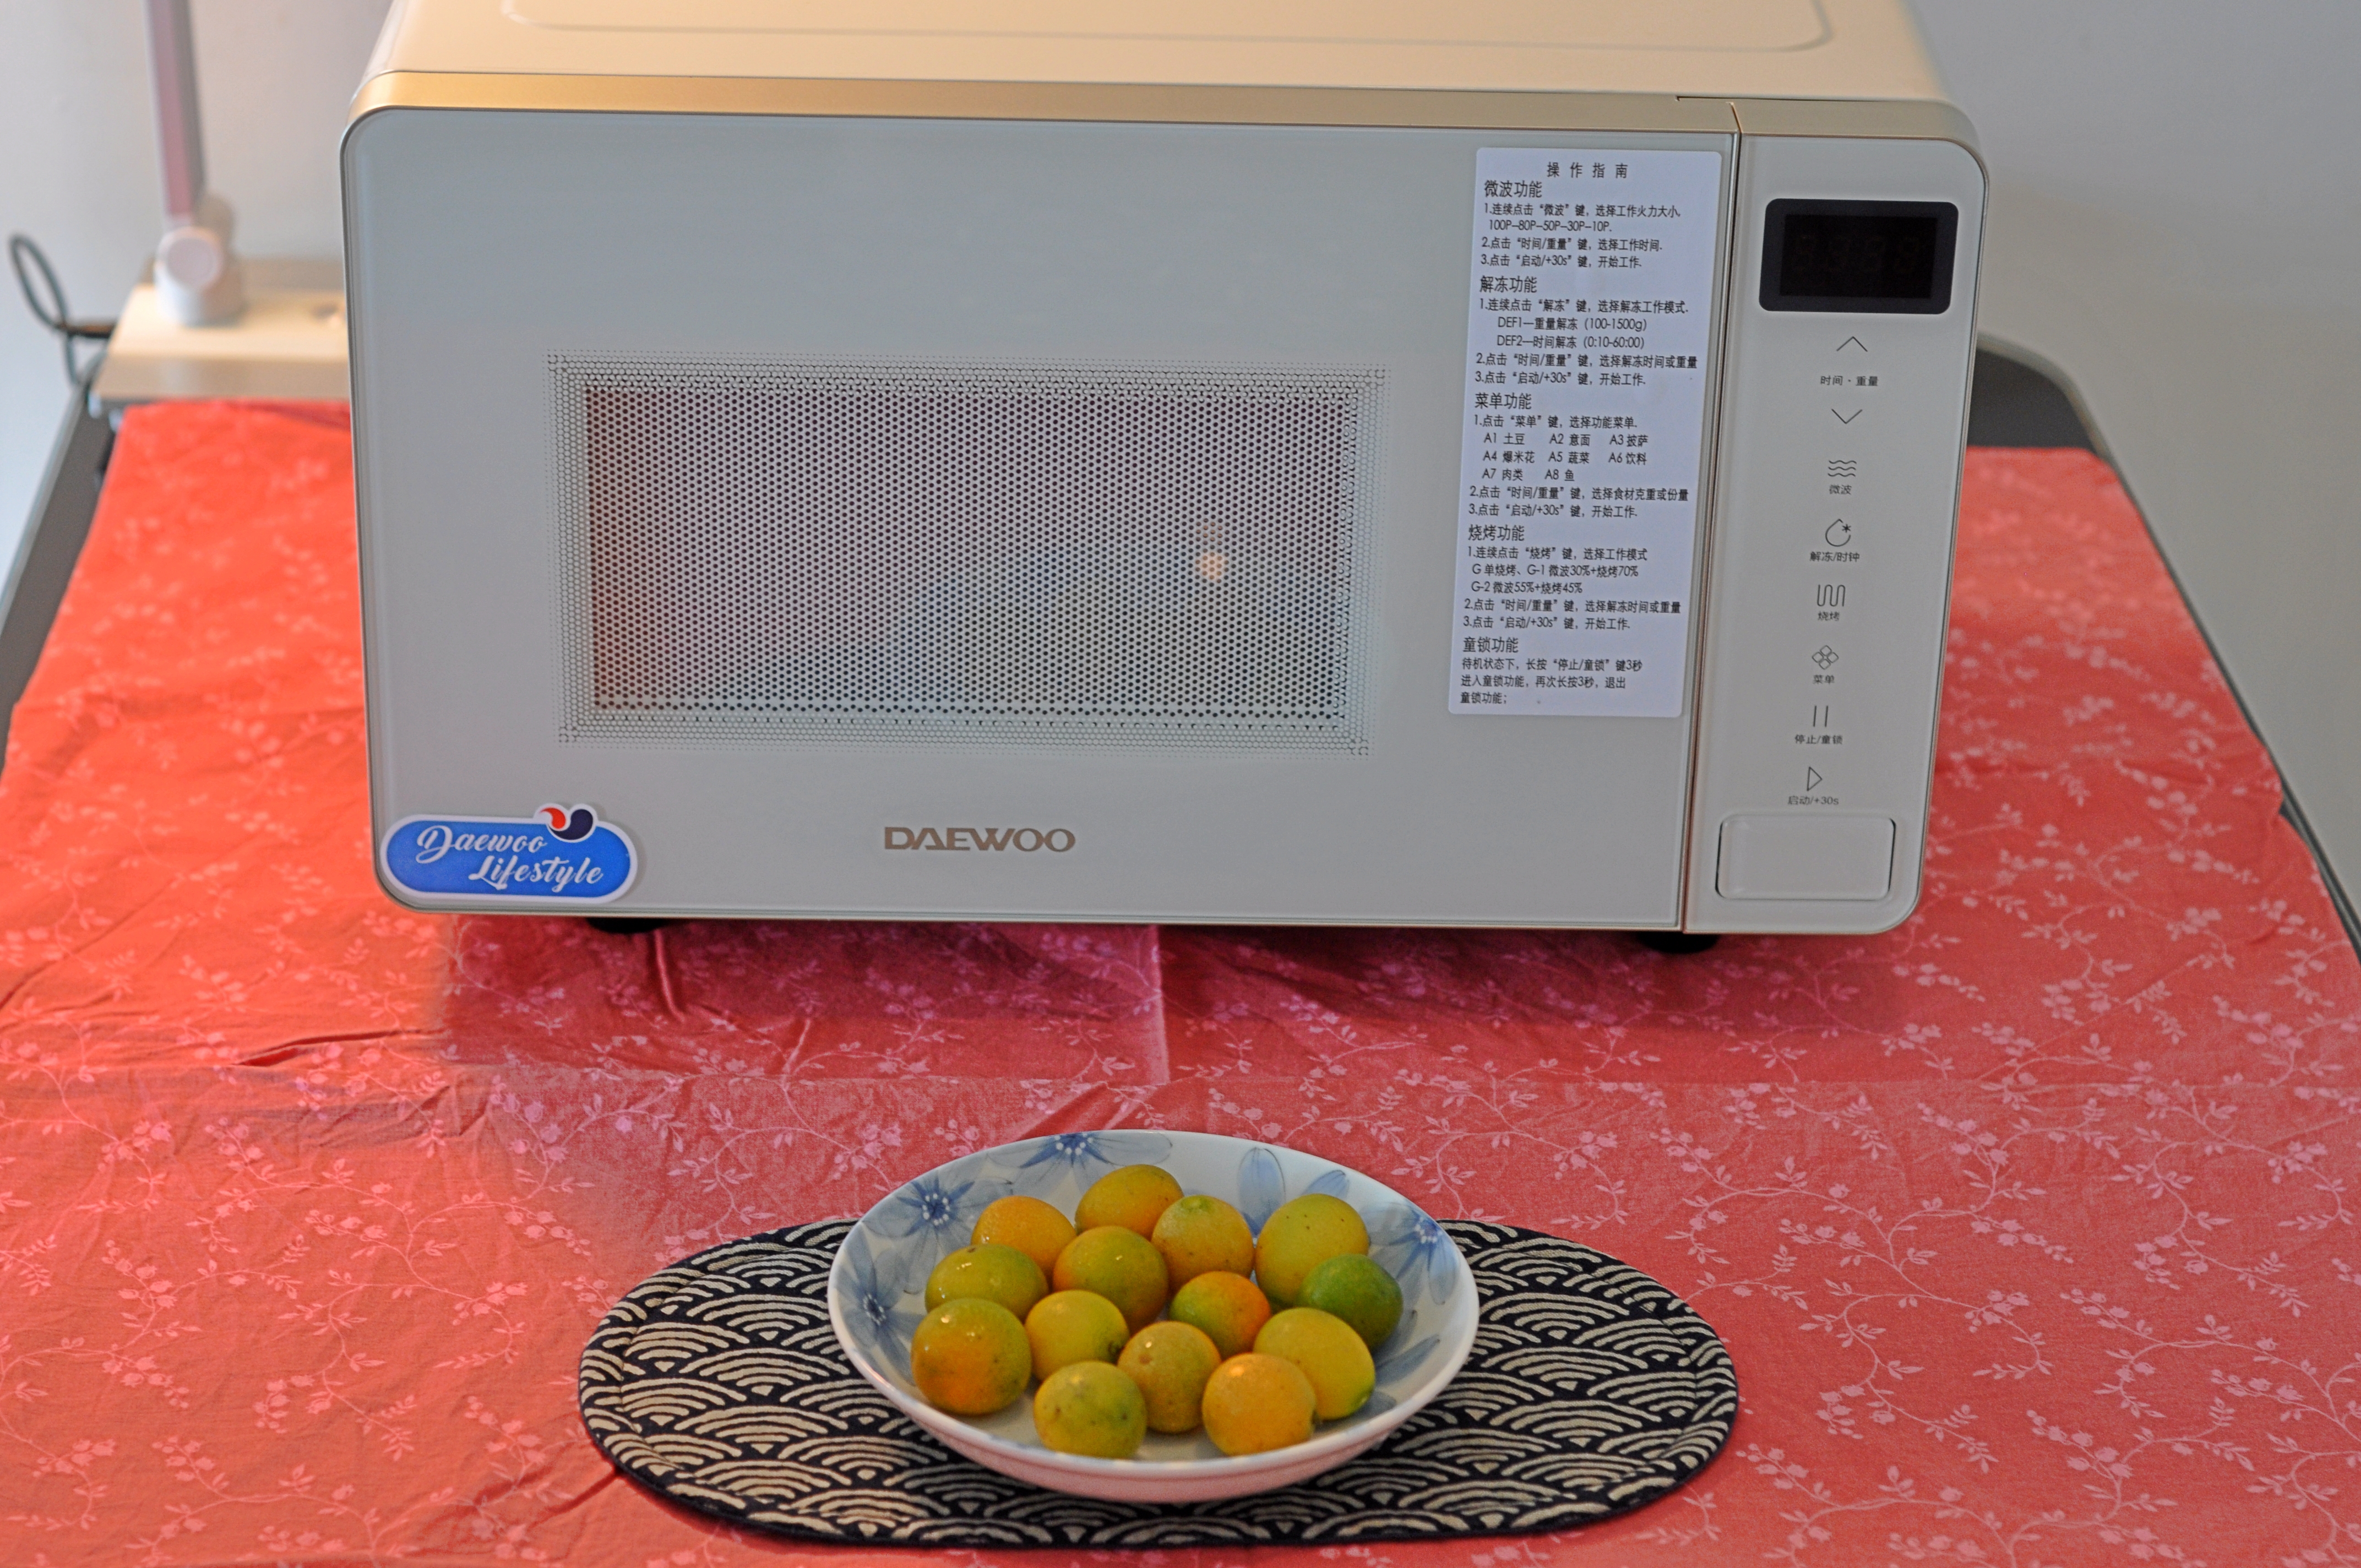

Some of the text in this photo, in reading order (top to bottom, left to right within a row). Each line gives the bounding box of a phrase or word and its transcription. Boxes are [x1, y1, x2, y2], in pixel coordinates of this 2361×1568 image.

[1546, 161, 1628, 179] 操作指南
[1484, 179, 1543, 198] 微波功能
[1479, 275, 1537, 293] 解冻功能
[1474, 391, 1532, 410] 菜单功能
[1483, 432, 1649, 448] A1 土豆 A2 意面 A3 披萨
[1482, 450, 1647, 466] A4 爆米花 A5 蔬菜 A6 饮料
[1481, 467, 1575, 482] A7 肉类 A8 鱼
[1829, 484, 1852, 495] 微波
[1467, 524, 1525, 542] 烧烤功能
[1809, 551, 1860, 563] 解冻/时钟
[1818, 611, 1840, 622] 烧烤
[1462, 635, 1519, 654] 童锁功能
[1813, 674, 1835, 684] 菜单
[1794, 734, 1843, 745] 停止/童锁
[1788, 795, 1839, 805] 启动/+30s
[416, 825, 547, 864] Daewoo
[884, 826, 1076, 853] DAEWOO
[468, 855, 603, 893] Lifestyle
